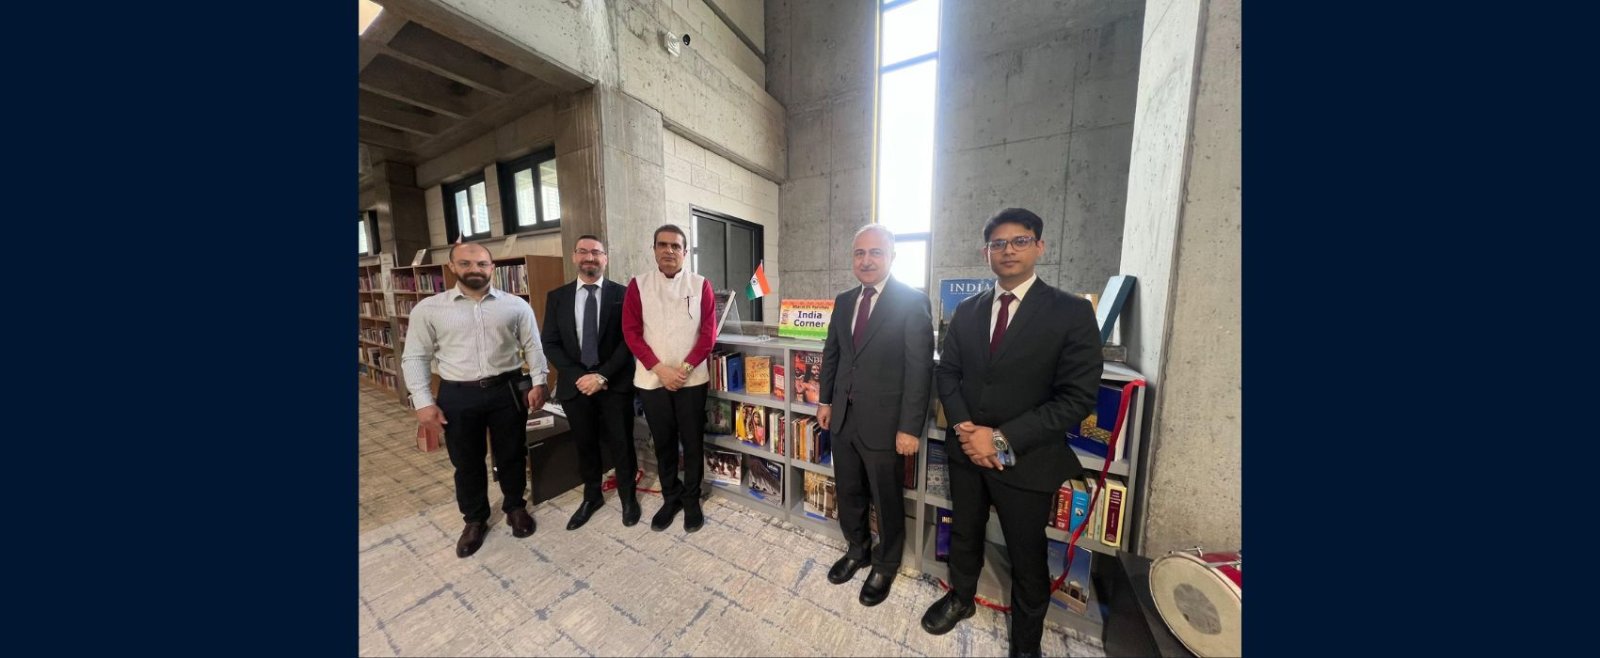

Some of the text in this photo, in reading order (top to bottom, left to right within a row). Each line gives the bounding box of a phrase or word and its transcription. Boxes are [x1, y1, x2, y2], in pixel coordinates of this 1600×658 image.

[798, 310, 823, 319] India
[793, 319, 826, 328] Corner
[805, 356, 823, 364] INDI
